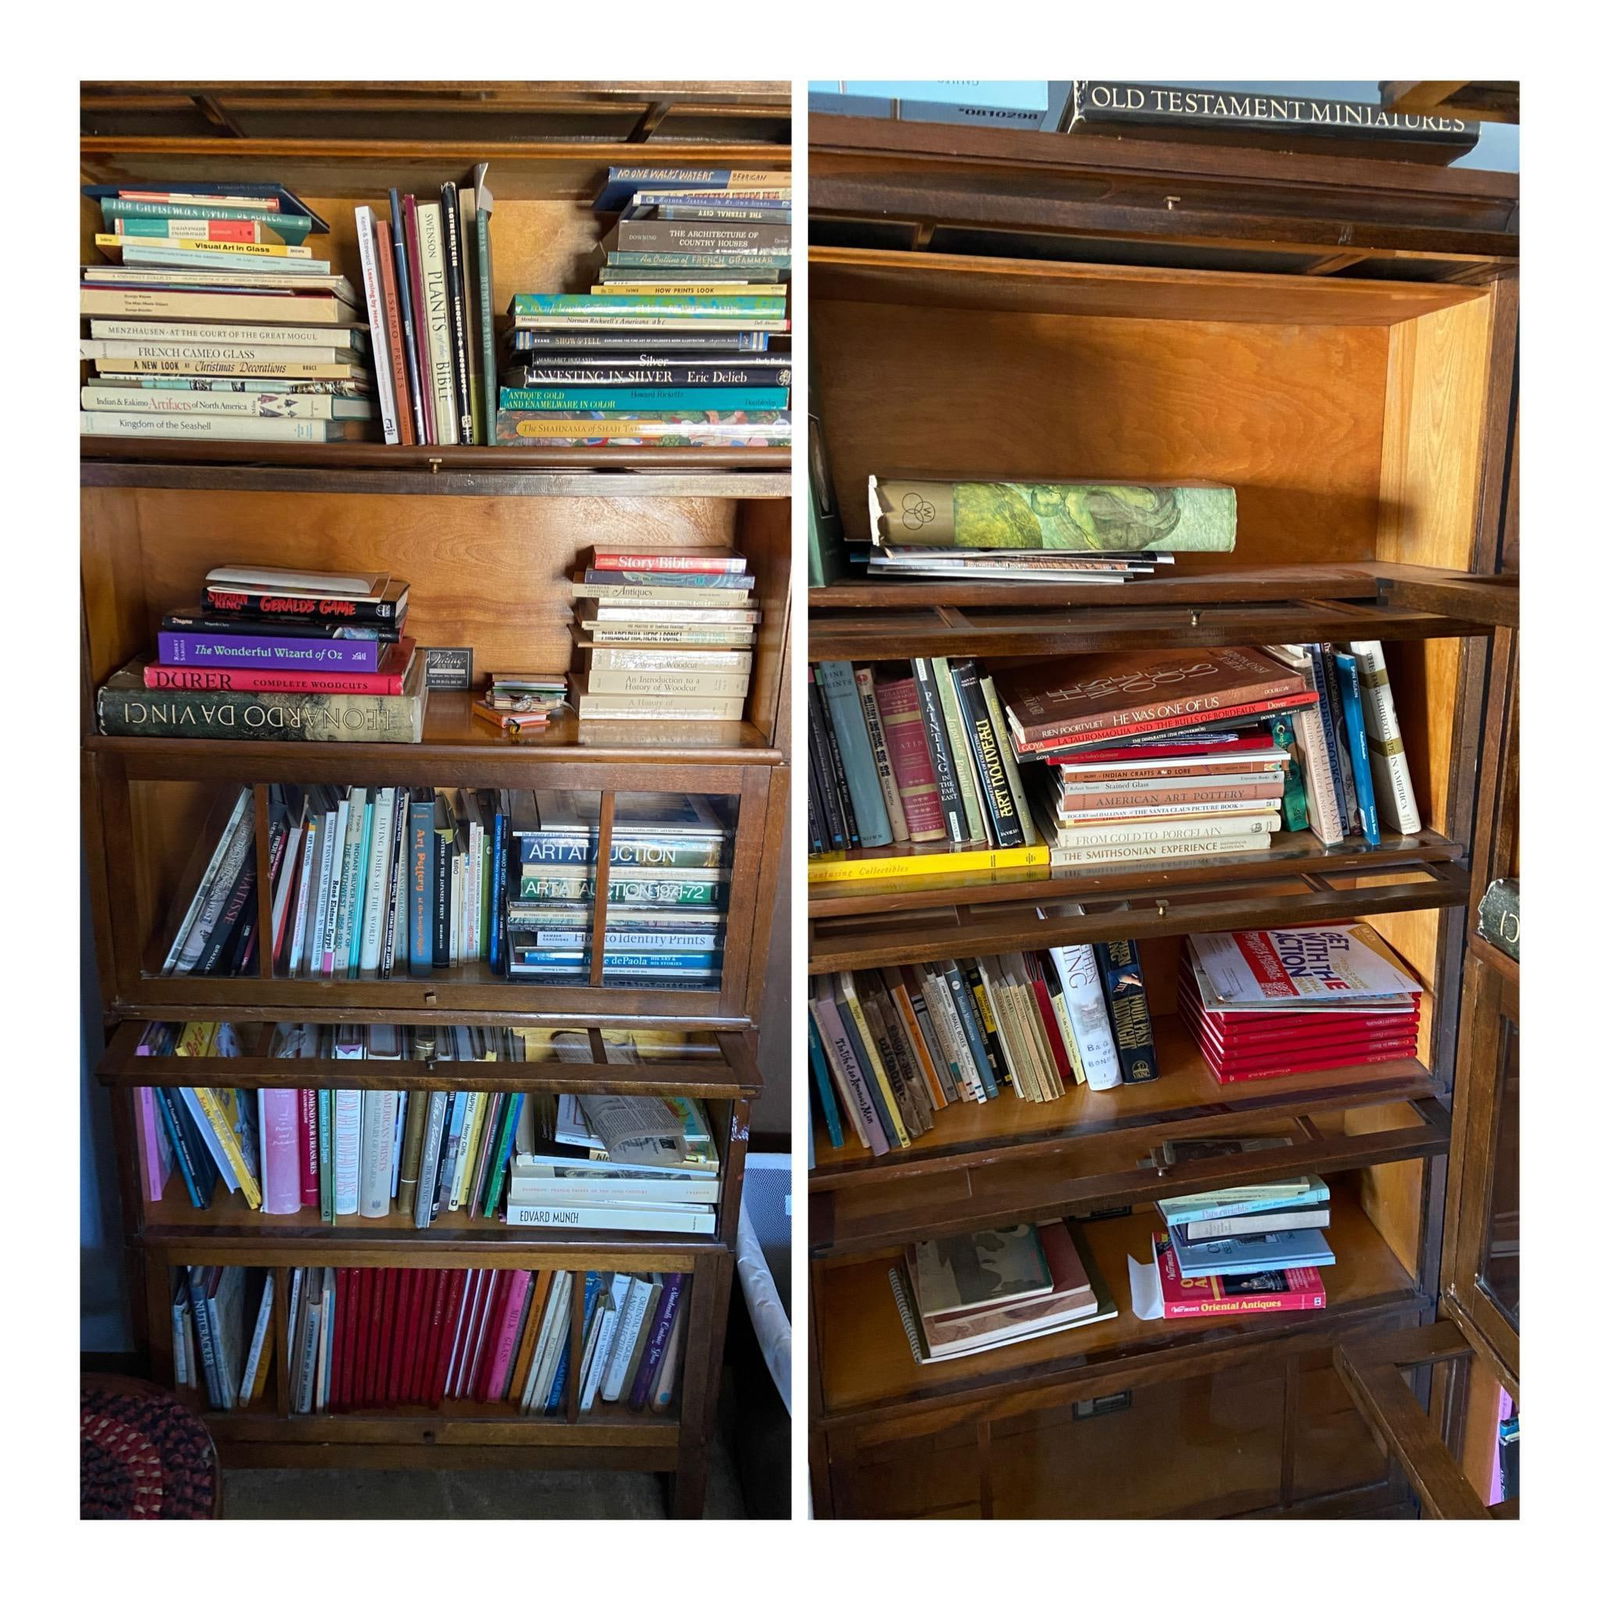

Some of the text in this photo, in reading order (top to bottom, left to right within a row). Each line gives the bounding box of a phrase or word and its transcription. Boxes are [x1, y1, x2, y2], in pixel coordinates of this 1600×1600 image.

[1092, 86, 1144, 110] OLD
[1150, 90, 1305, 119] TESTAMENT
[632, 169, 649, 179] ONE
[650, 169, 678, 180] WALKS
[679, 171, 714, 182] WATERS
[195, 242, 221, 250] Visual
[246, 245, 270, 253] Glass
[367, 268, 376, 302] Learning
[372, 311, 380, 329] Heart
[425, 214, 451, 401] SWENSON PLANTS BIBLE
[138, 347, 255, 358] FRENCH CAMEO GLASS
[140, 362, 157, 370] NEW
[161, 362, 179, 370] LOOK
[194, 361, 235, 373] Christmas
[239, 362, 286, 373] Decorations
[639, 355, 669, 366] Silver
[532, 370, 747, 382] INVESTING IN SILVER Eric Delieb
[508, 392, 542, 400] ANTIQUE
[124, 398, 148, 406] Eskimo
[148, 398, 192, 410] Artifacts
[119, 420, 153, 430] Kingdom
[181, 421, 211, 430] Seashell
[618, 556, 693, 570] Story Bible
[215, 601, 242, 610] KING
[320, 601, 356, 616] GAME
[195, 645, 211, 655] The
[215, 646, 272, 657] Wonderful
[275, 648, 313, 659] Wizard
[327, 651, 342, 660] Oz
[253, 679, 306, 688] COMPLETE
[311, 681, 368, 690] WOODCUTS
[124, 703, 390, 730] LEONARDO DA VINCI
[1113, 715, 1130, 727] HE
[1132, 710, 1155, 723] WAS
[1158, 706, 1182, 719] ONE
[1185, 702, 1201, 714] OF
[1204, 698, 1219, 708] US
[926, 692, 949, 772] PAINTING
[1022, 742, 1045, 751] GOYA
[1156, 721, 1173, 729] THE
[1174, 717, 1199, 727] BULLS
[1214, 704, 1256, 720] BORDEAUX
[1268, 701, 1287, 710] Dover
[976, 719, 1004, 786] NOUVEAU
[1327, 743, 1340, 784] BOOKS
[1390, 756, 1397, 767] IN
[1105, 781, 1130, 790] Stained
[1393, 769, 1407, 810] AMERICA
[996, 788, 1014, 818] ART
[1096, 790, 1244, 806] AMERICAN ART POTTERY
[1143, 831, 1158, 840] TO
[529, 845, 676, 862] ART AT UCTION
[1063, 842, 1218, 861] THE SMITHSONIAN EXPERIENCE
[416, 829, 426, 891] Art Pottery
[655, 886, 704, 899] 1971-72
[669, 935, 705, 945] Prints
[1320, 932, 1349, 951] GET
[612, 956, 647, 965] dePaola
[1272, 932, 1313, 978] ACTION
[1300, 932, 1350, 990] WITH THE
[1130, 994, 1144, 1019] FOUR
[1136, 1021, 1150, 1046] PAST
[835, 1038, 844, 1052] The
[862, 1105, 872, 1124] Man
[520, 1211, 579, 1224] EDVARD MUNCH
[1201, 1302, 1239, 1312] Oriental
